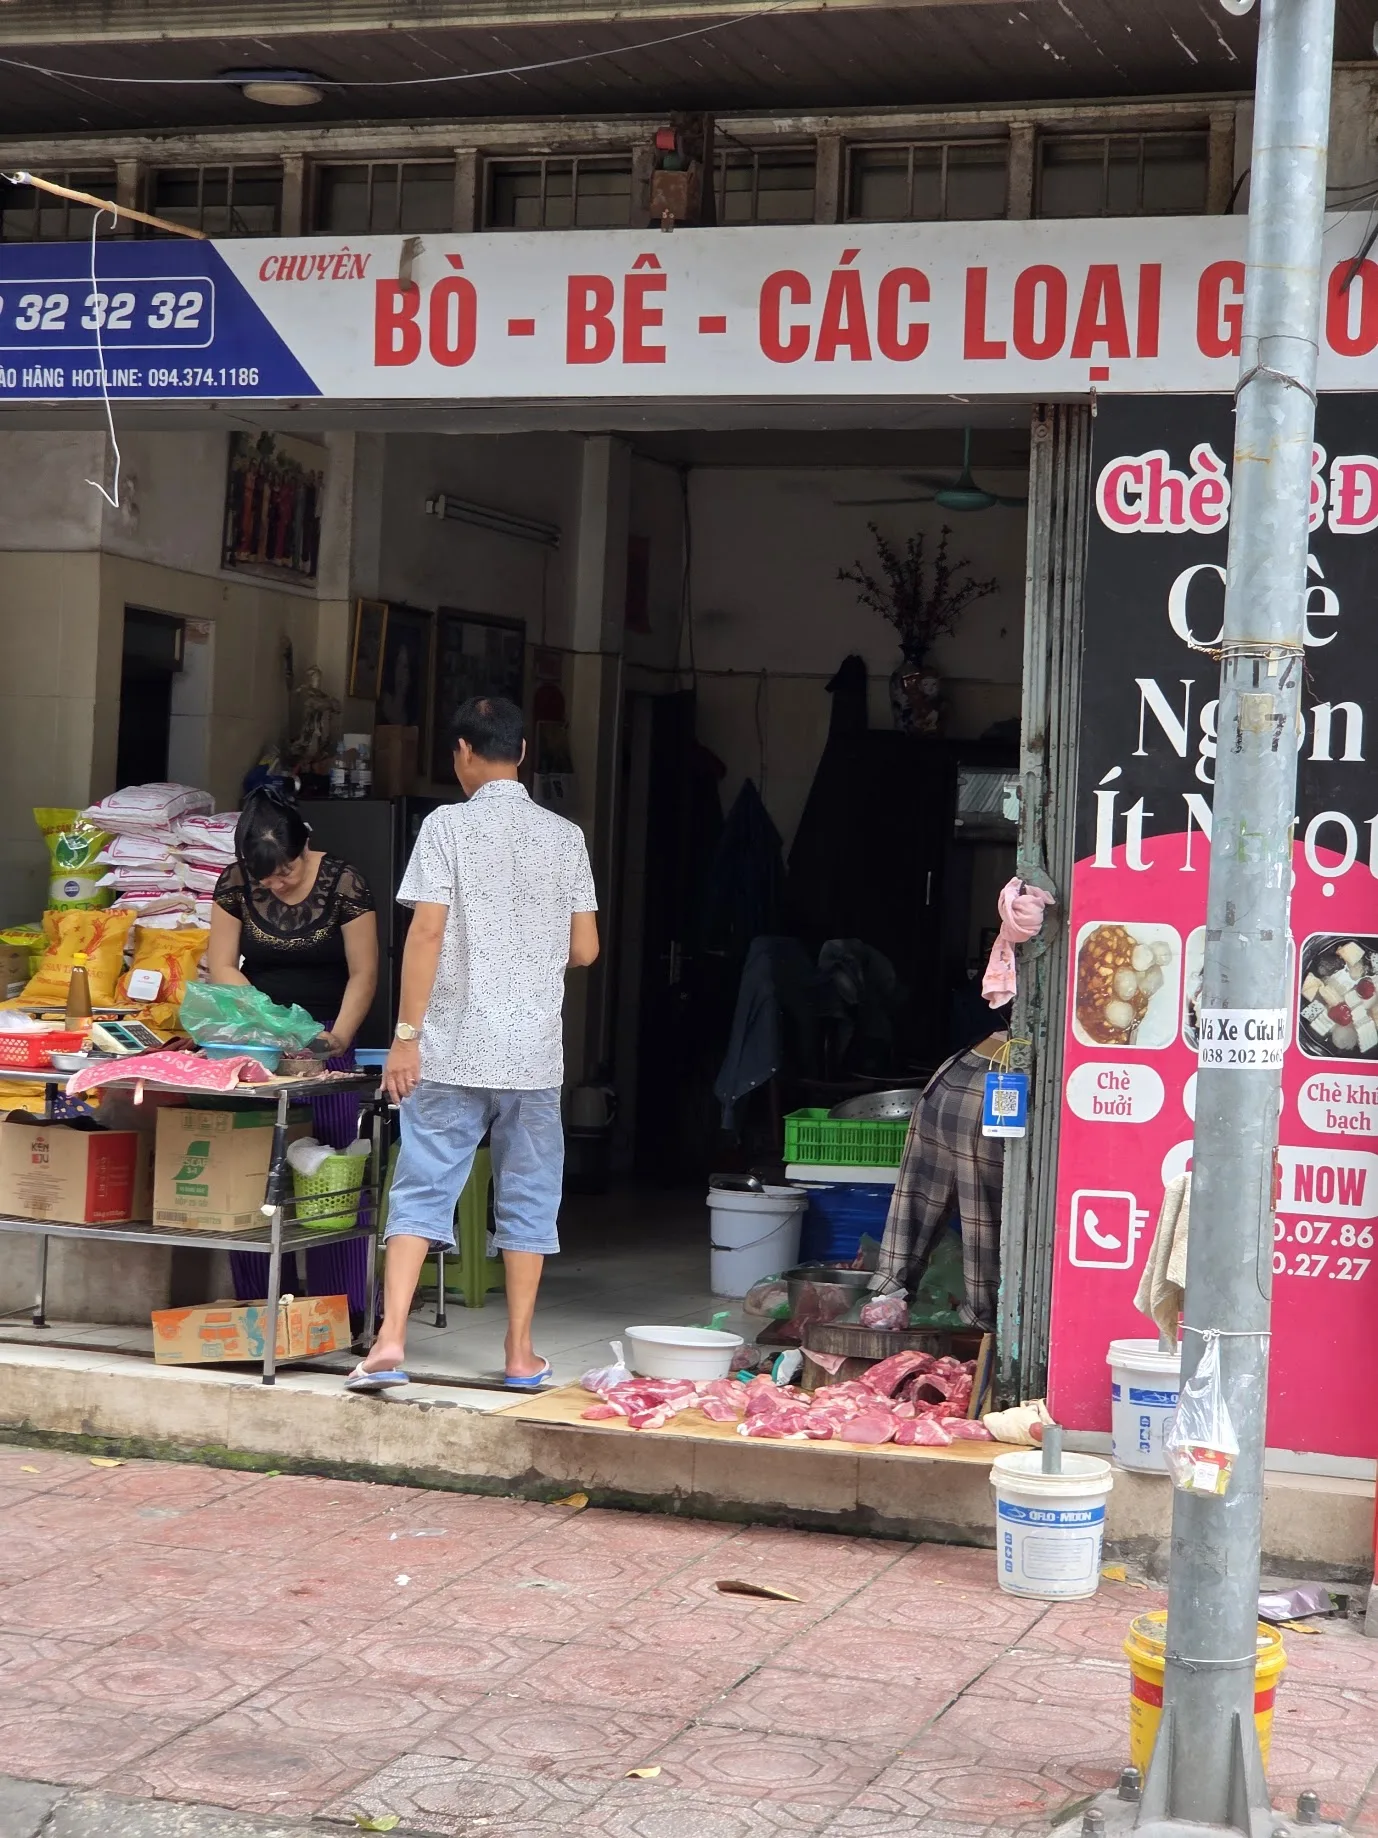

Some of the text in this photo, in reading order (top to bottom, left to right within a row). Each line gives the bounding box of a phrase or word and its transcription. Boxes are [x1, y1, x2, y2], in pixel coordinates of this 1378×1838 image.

[259, 247, 371, 282] CHUYÊN
[15, 294, 69, 330] 32
[81, 293, 136, 330] 32
[148, 292, 203, 329] 32
[375, 254, 477, 366] BÒ
[566, 253, 667, 364] BÊ
[759, 249, 930, 363] CÁC
[963, 263, 1162, 381] LOẠI
[1197, 259, 1378, 359] GO
[72, 368, 143, 387] HOTLINE:
[148, 367, 260, 386] 094.374.1186
[1099, 446, 1230, 530] Chè
[1090, 766, 1154, 872] Ít
[1201, 1018, 1213, 1040] Vá
[1217, 1018, 1238, 1041] Xe
[1202, 1048, 1223, 1063] 038
[1228, 1049, 1256, 1063] 202
[1097, 1071, 1130, 1091] Chè
[1307, 1082, 1342, 1103] Chè
[1092, 1093, 1132, 1116] bưởi
[1326, 1109, 1371, 1135] bạch
[1294, 1163, 1367, 1206] NOW
